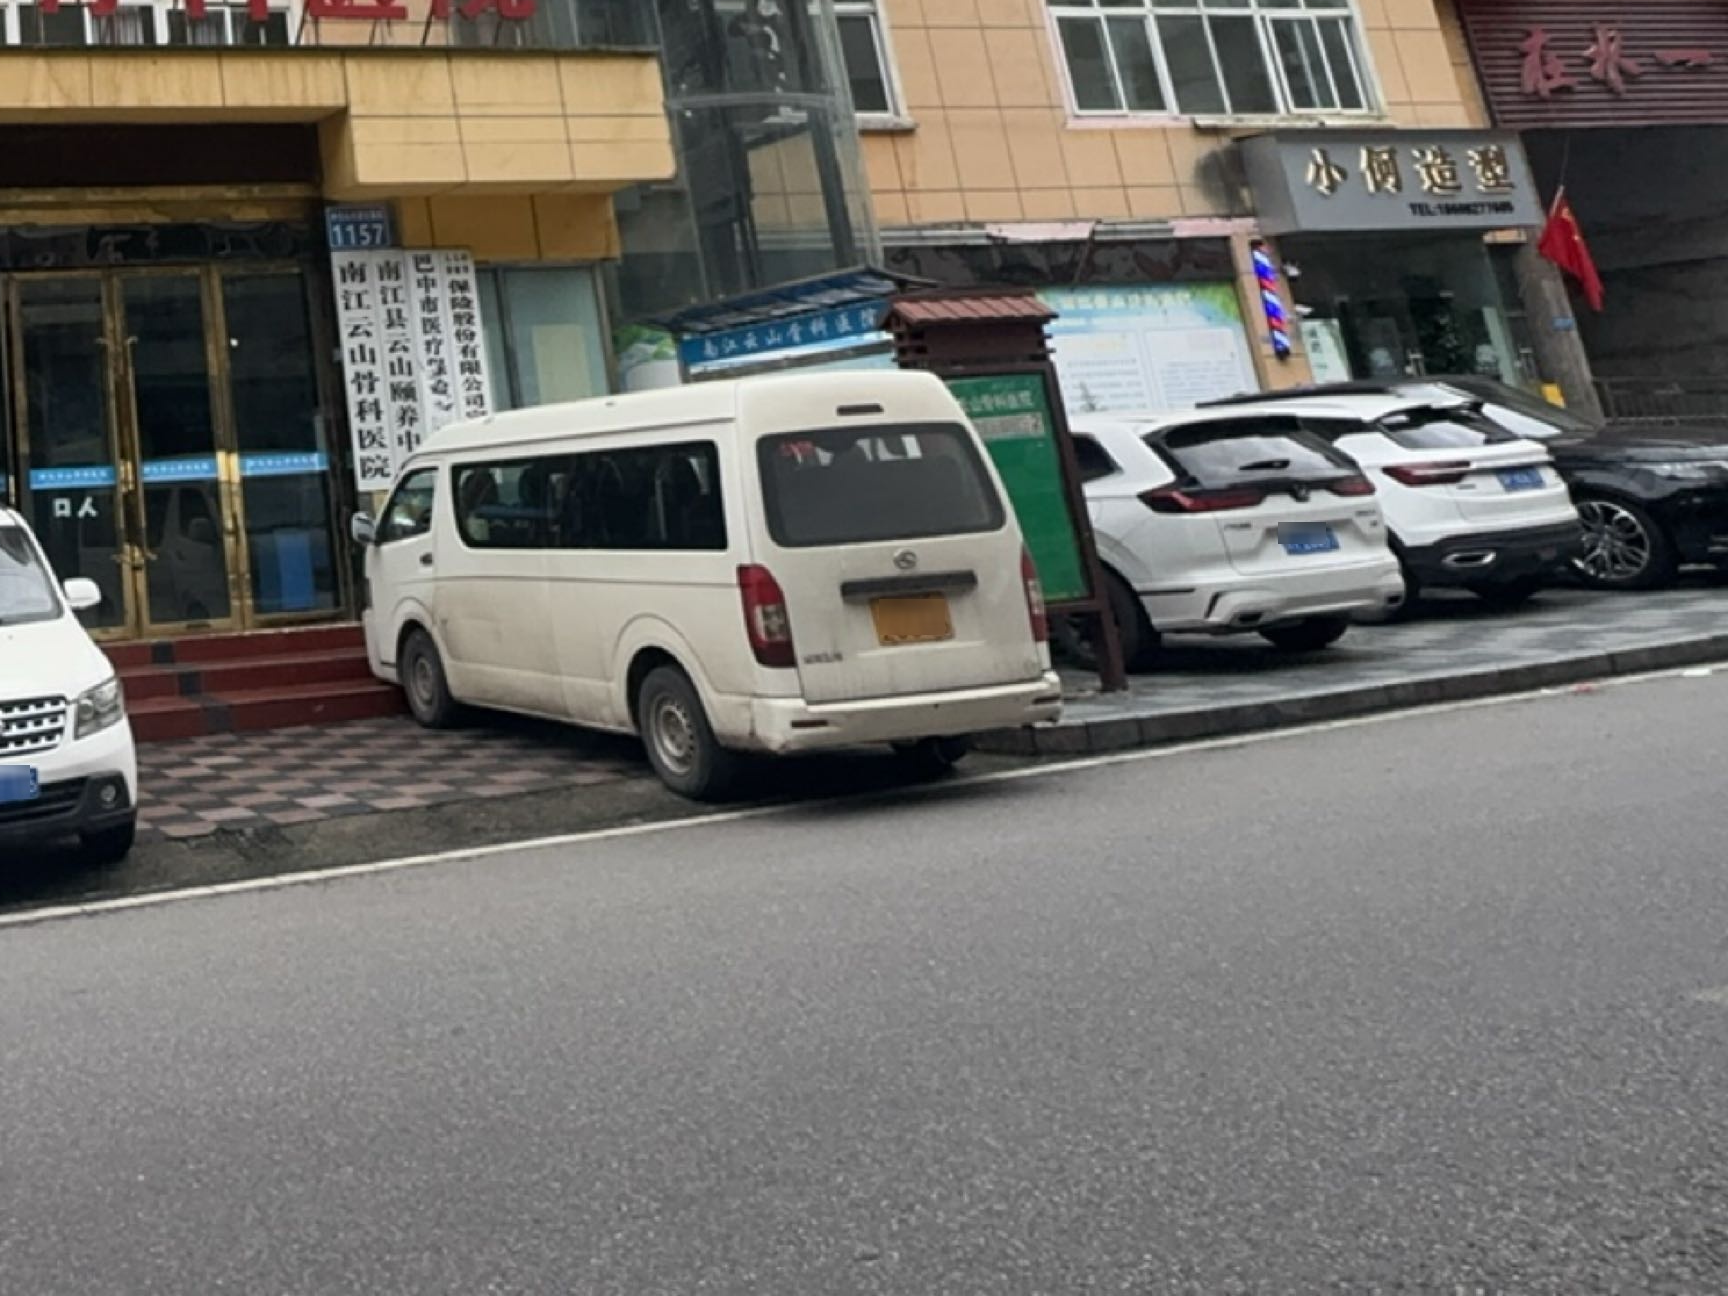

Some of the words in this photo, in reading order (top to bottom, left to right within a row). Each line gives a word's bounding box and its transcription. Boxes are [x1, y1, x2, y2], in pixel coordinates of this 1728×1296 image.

[332, 223, 383, 246] 1157
[339, 260, 392, 479] 南江云山骨科医院
